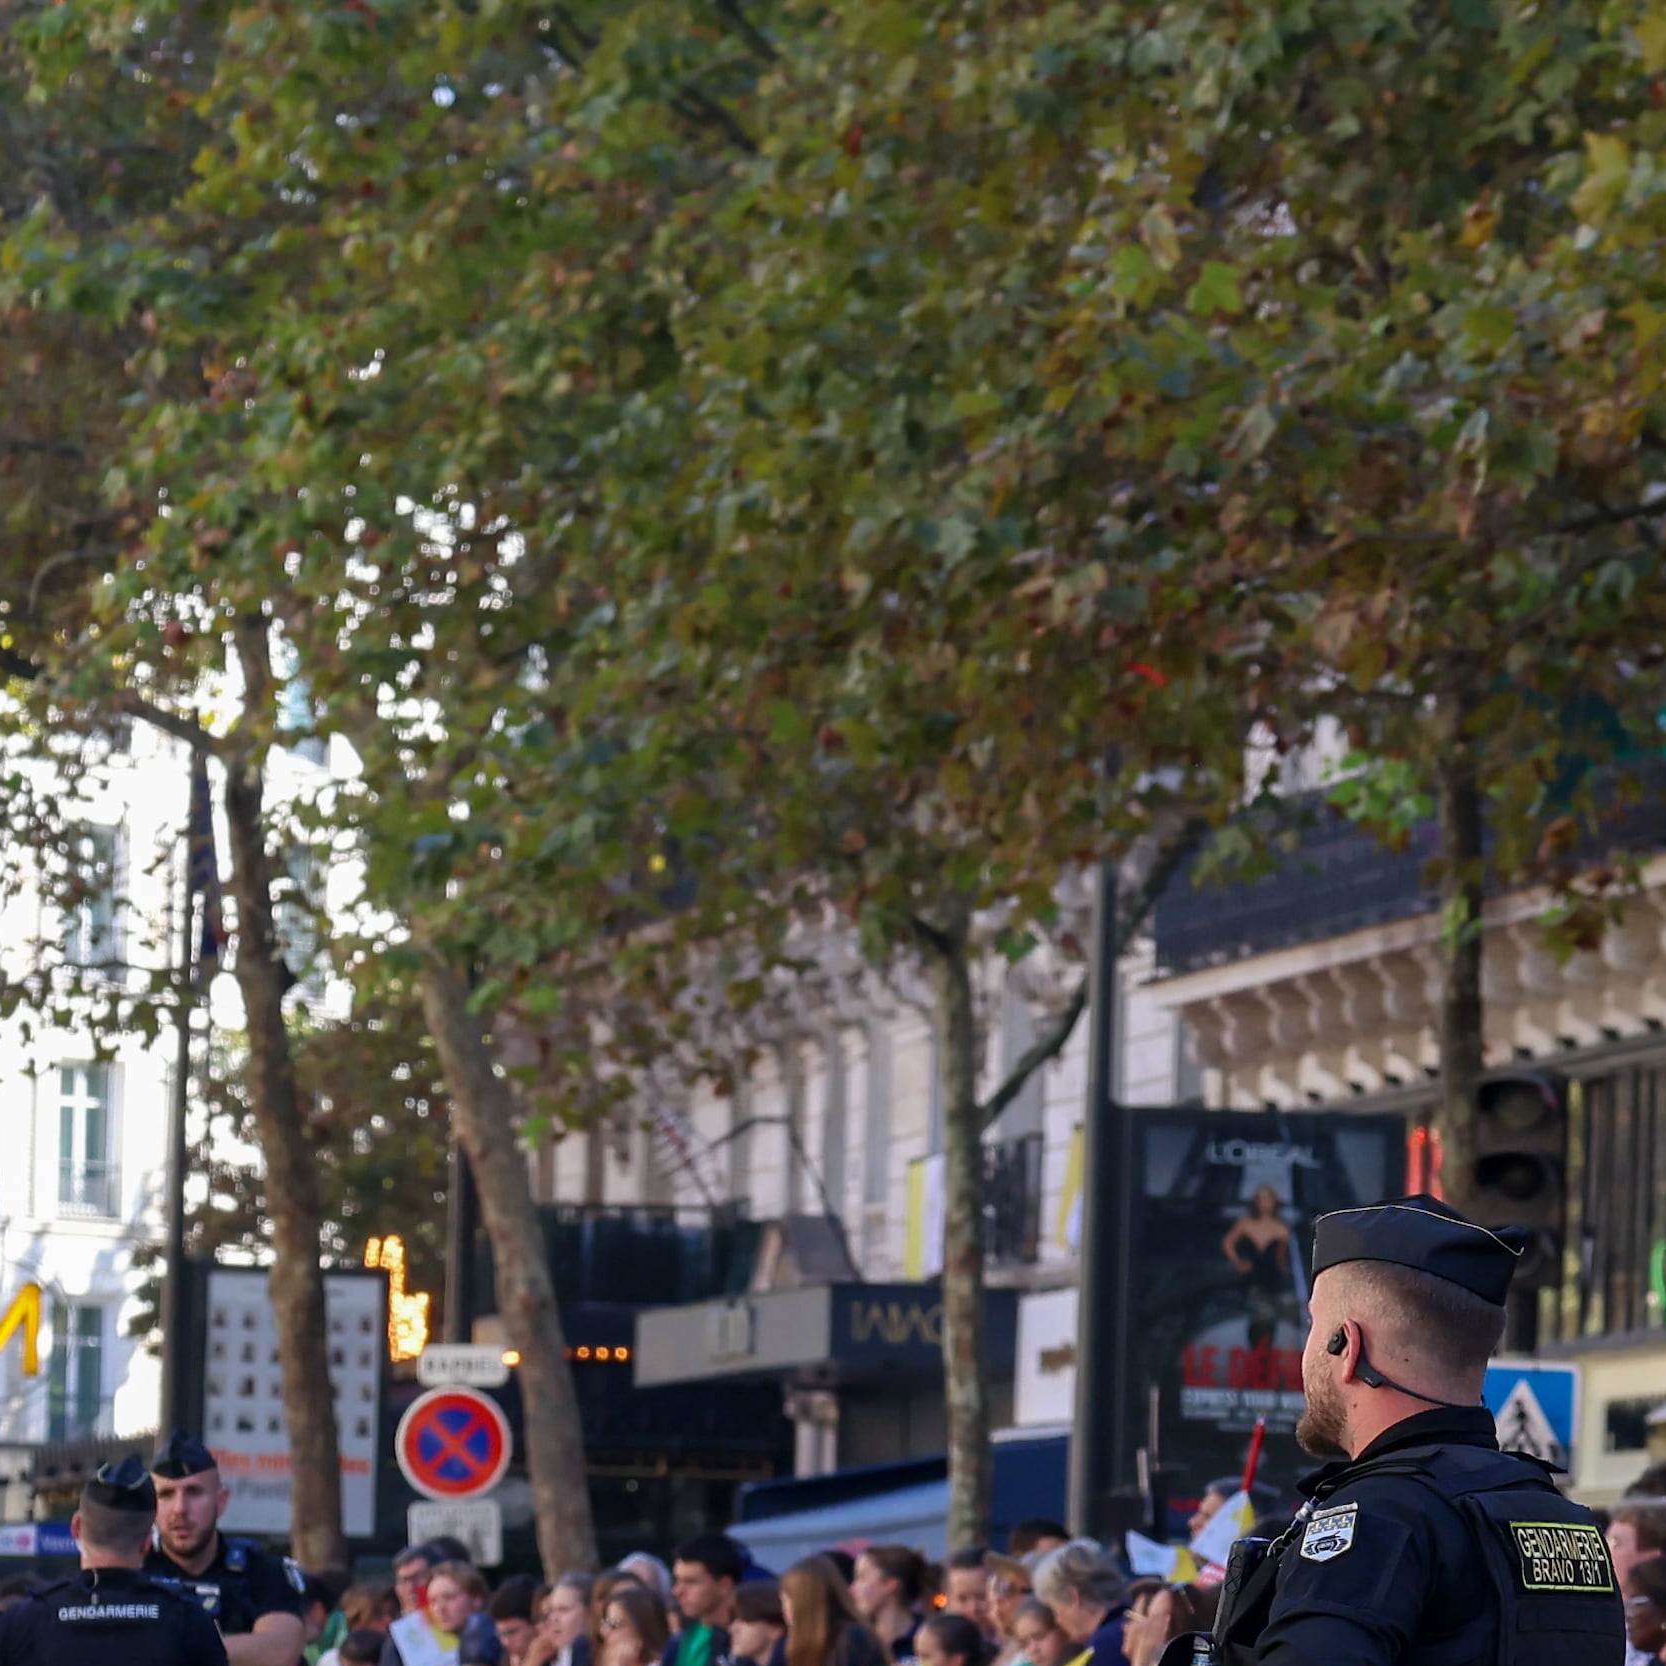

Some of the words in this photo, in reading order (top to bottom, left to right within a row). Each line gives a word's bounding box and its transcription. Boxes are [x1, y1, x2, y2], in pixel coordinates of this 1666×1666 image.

[1182, 1344, 1219, 1387] LE
[1517, 1528, 1606, 1561] GENDARMERIE
[1532, 1558, 1575, 1583] BRAVO
[1579, 1561, 1602, 1584] 13/1
[58, 1604, 159, 1621] GENDARMERIE
